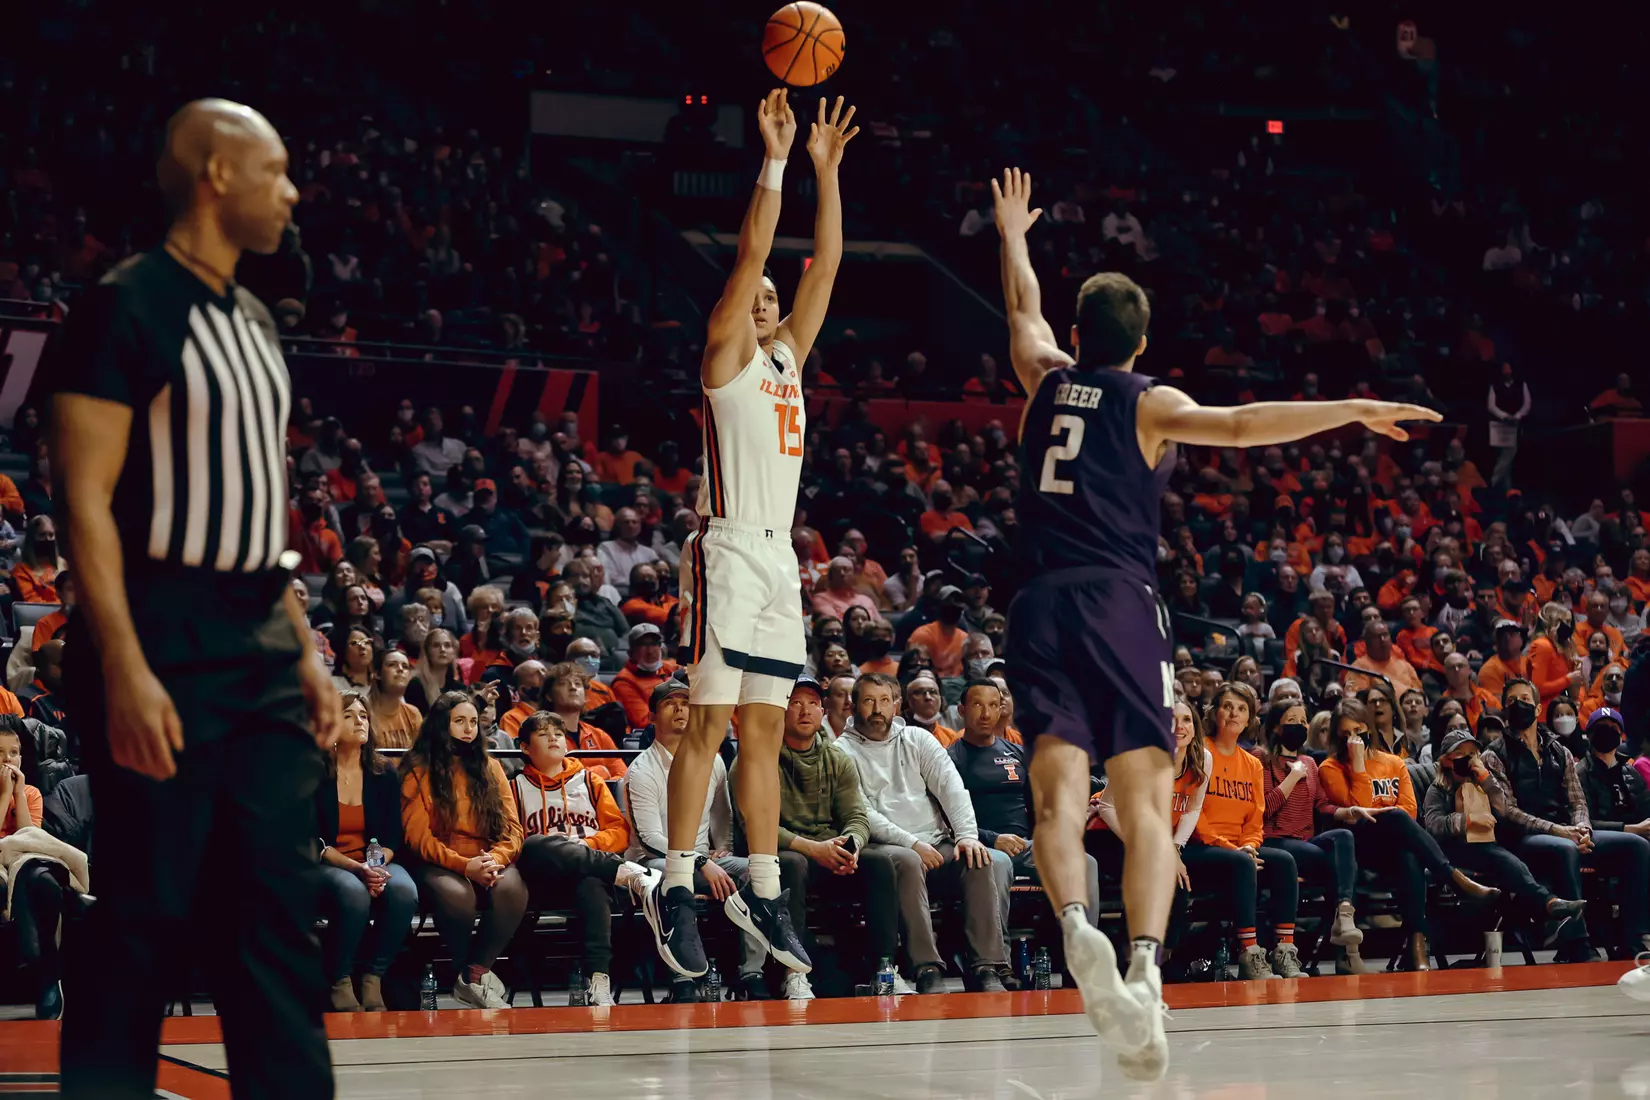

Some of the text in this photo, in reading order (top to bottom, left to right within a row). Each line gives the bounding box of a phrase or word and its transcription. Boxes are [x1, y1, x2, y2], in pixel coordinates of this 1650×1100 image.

[774, 403, 803, 457] 15
[1039, 414, 1085, 494] 2
[1601, 706, 1611, 717] N
[1206, 776, 1253, 802] LLINOIS
